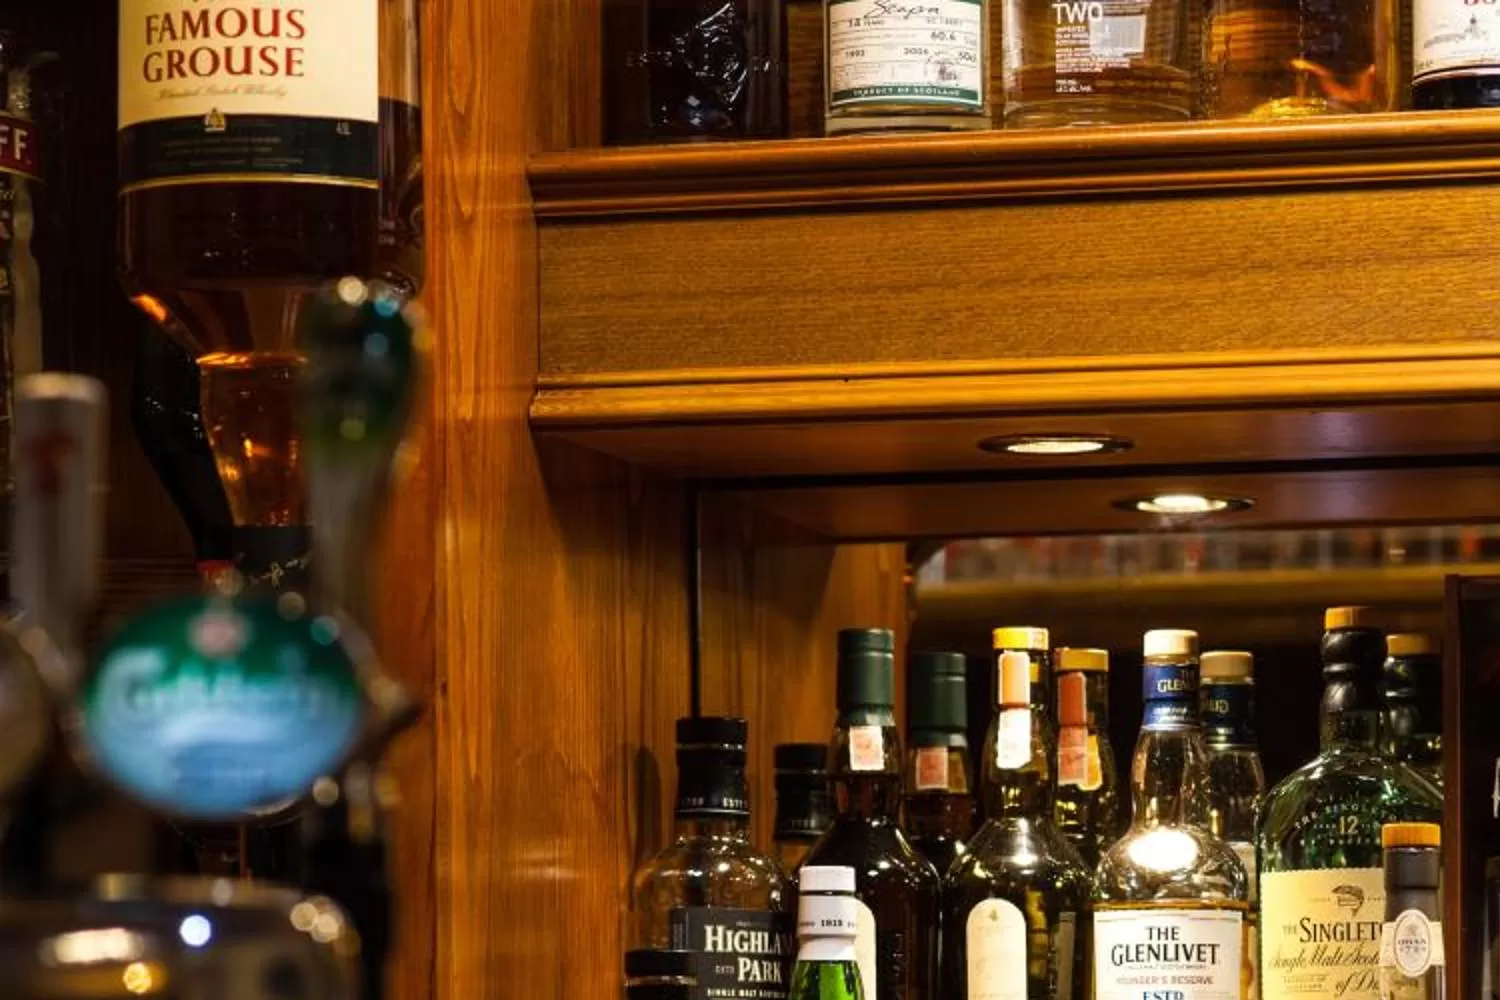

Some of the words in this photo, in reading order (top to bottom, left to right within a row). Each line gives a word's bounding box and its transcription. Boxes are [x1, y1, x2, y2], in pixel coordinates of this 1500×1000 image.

[1052, 2, 1104, 24] TWO
[145, 8, 305, 46] FAMOUS
[143, 46, 305, 83] GROUSE
[1146, 926, 1181, 941] THE
[1300, 916, 1384, 944] SINGLET
[1111, 943, 1221, 967] GLENLIVET
[737, 957, 783, 984] PARK
[1171, 975, 1215, 986] RESERVE
